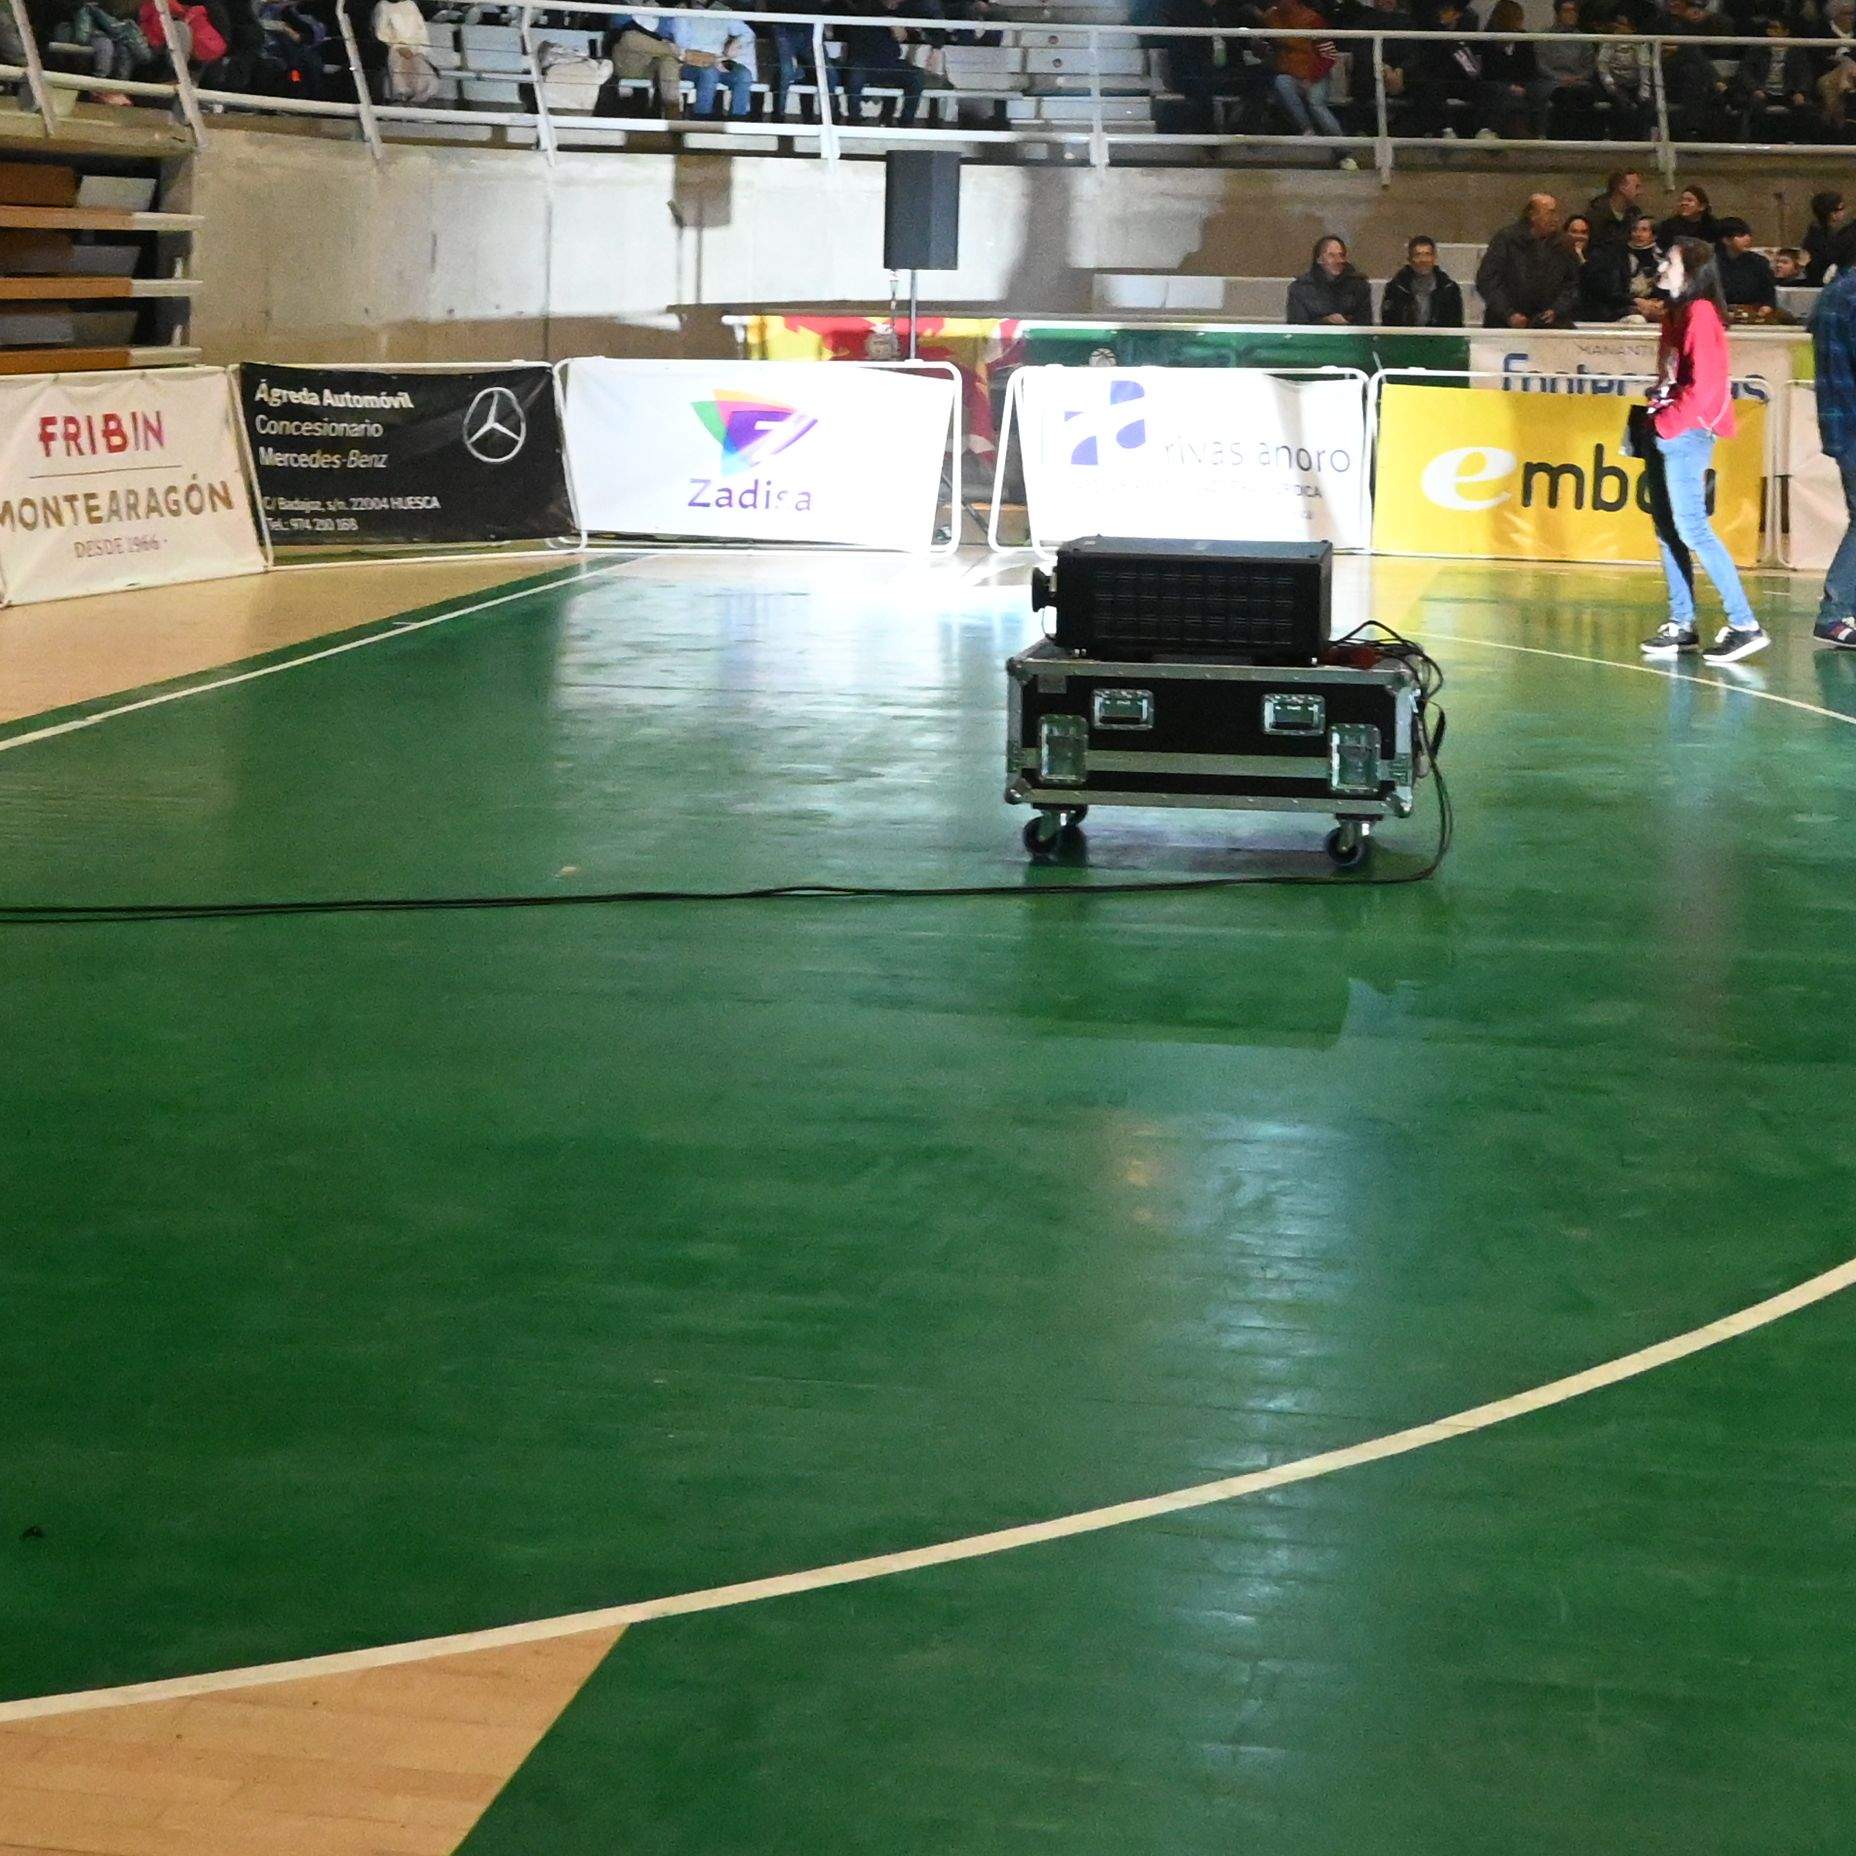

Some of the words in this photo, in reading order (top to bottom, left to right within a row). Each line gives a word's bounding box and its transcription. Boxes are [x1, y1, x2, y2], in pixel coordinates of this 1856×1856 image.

[255, 379, 320, 407] Ágreda
[323, 389, 414, 409] Automóvil
[38, 411, 166, 457] FRIBIN
[255, 414, 384, 438] Concesionario
[259, 447, 388, 469] Mercedes-Benz
[390, 496, 441, 509] HUESCA
[74, 537, 124, 558] DESDE
